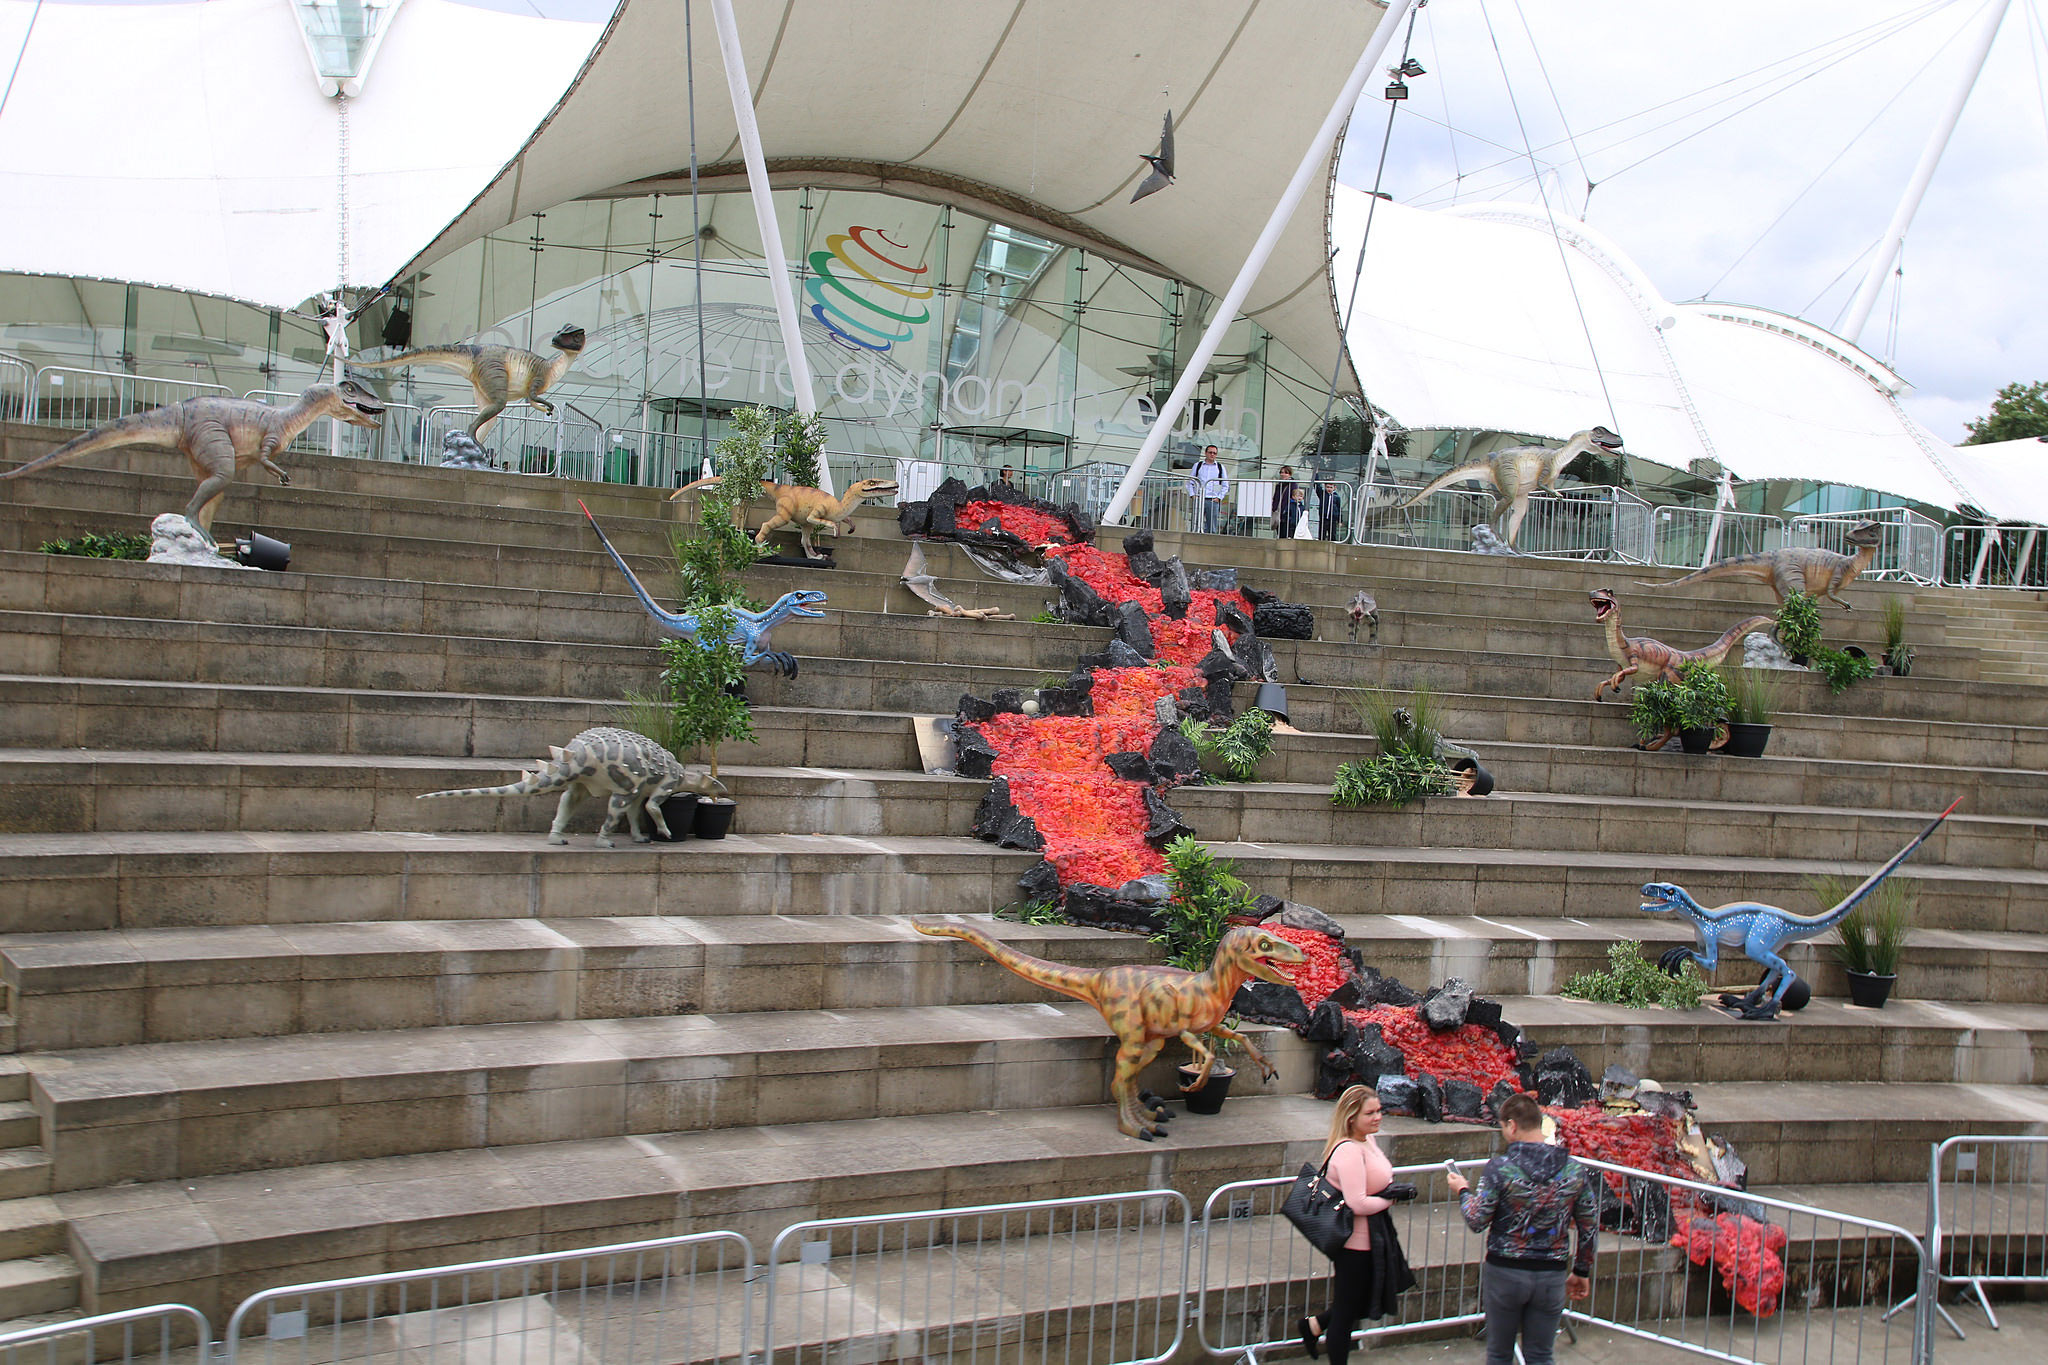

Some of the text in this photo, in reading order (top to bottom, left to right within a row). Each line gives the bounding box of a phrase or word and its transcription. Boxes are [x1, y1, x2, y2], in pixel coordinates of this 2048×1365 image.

[753, 342, 814, 397] to
[835, 352, 1100, 426] dynamic
[1122, 393, 1261, 452] earth
